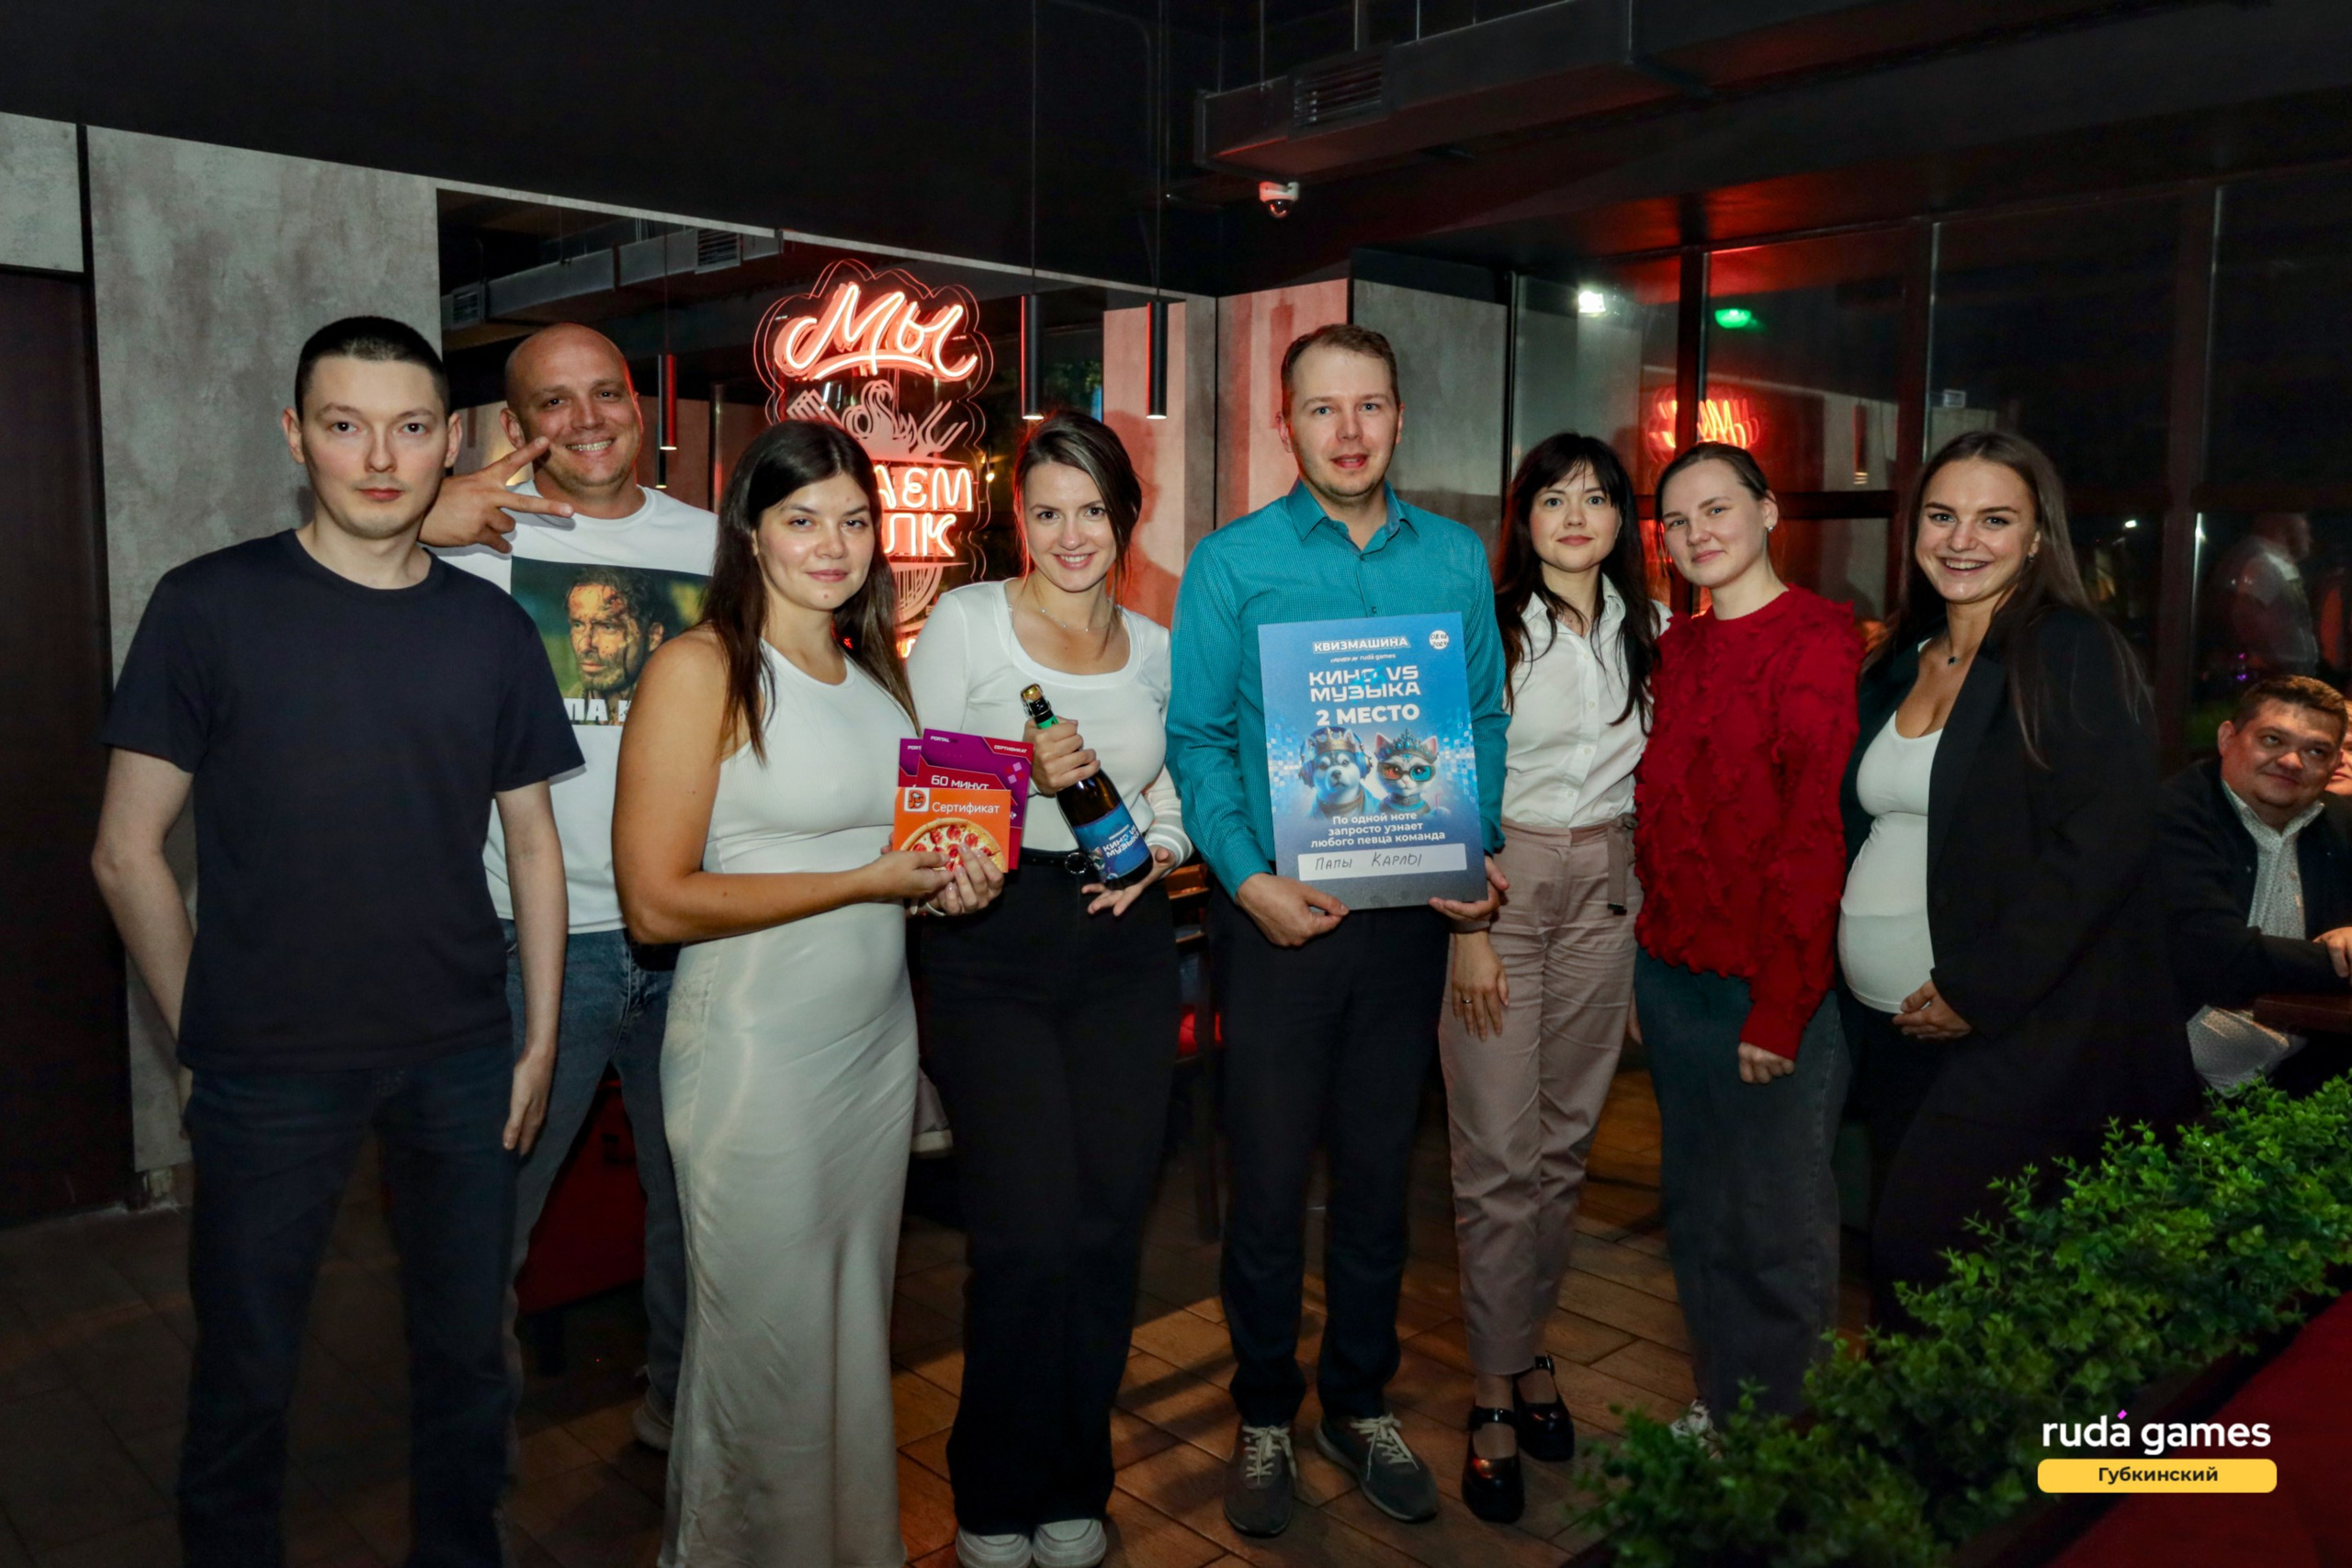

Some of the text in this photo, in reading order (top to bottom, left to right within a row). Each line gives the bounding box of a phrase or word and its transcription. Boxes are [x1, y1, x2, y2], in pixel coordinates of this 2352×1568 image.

[1314, 637, 1408, 652] КВИЗМАШИНА
[1309, 665, 1419, 686] КИНО VS
[1310, 682, 1421, 703] МУЗЫКА
[1316, 704, 1420, 727] 2 МЕСТО
[993, 745, 1028, 753] СЕРТИФИКАТ
[931, 774, 949, 786] 60
[932, 802, 1001, 815] Сертификат
[1332, 812, 1418, 825] По одной ноте
[1328, 822, 1424, 837] запросто узнает
[1310, 831, 1446, 848] любого певца команда
